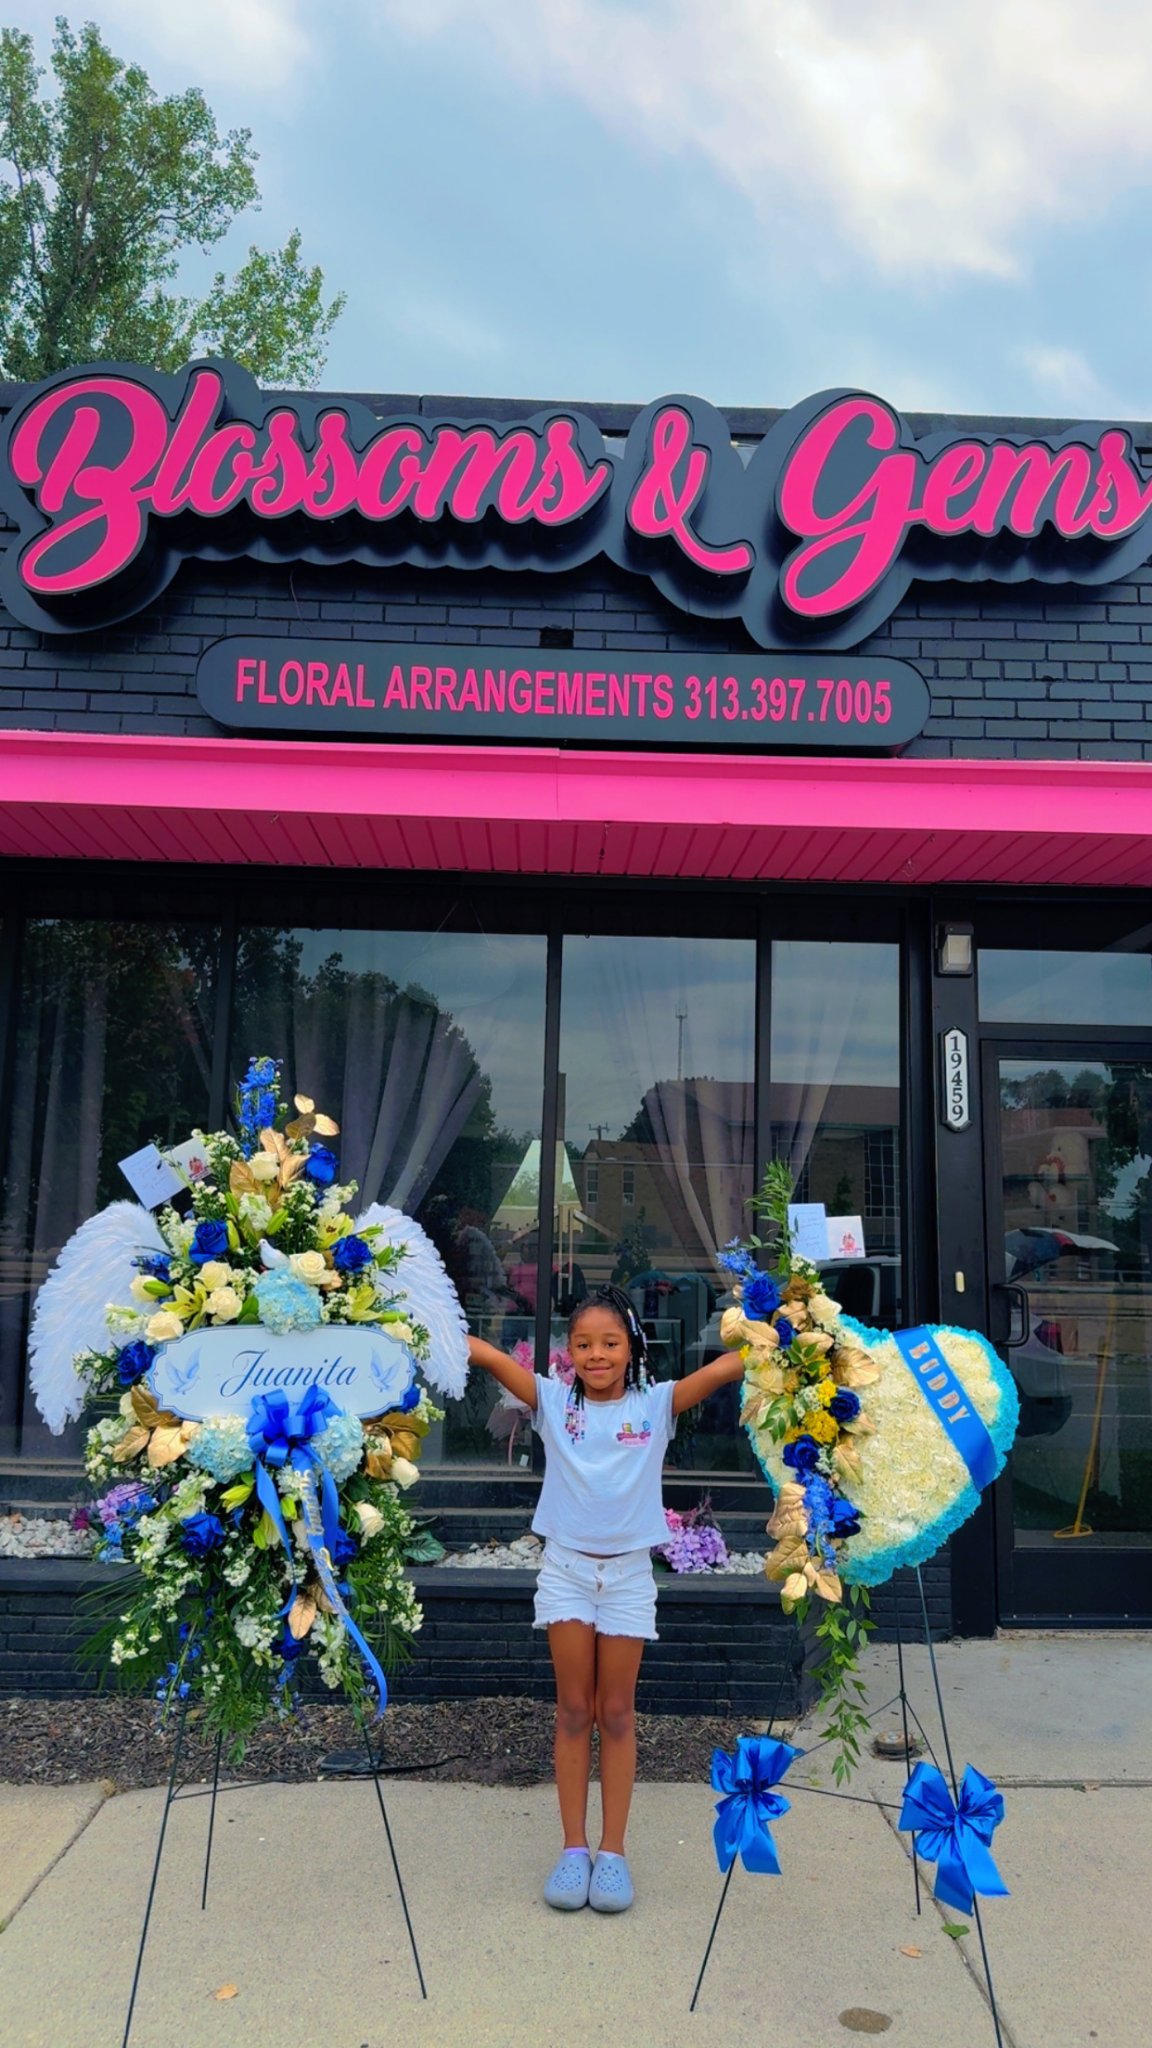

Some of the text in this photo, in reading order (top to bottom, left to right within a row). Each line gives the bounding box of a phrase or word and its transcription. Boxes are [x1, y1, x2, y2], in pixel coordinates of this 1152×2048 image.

[11, 373, 1152, 616] Blossoms & Gems
[235, 659, 893, 724] FLORAL ARRANGEMENTS 313.397.7005
[950, 1036, 964, 1122] 19459
[220, 1348, 359, 1398] Juanita
[908, 1341, 971, 1424] BUDDY
